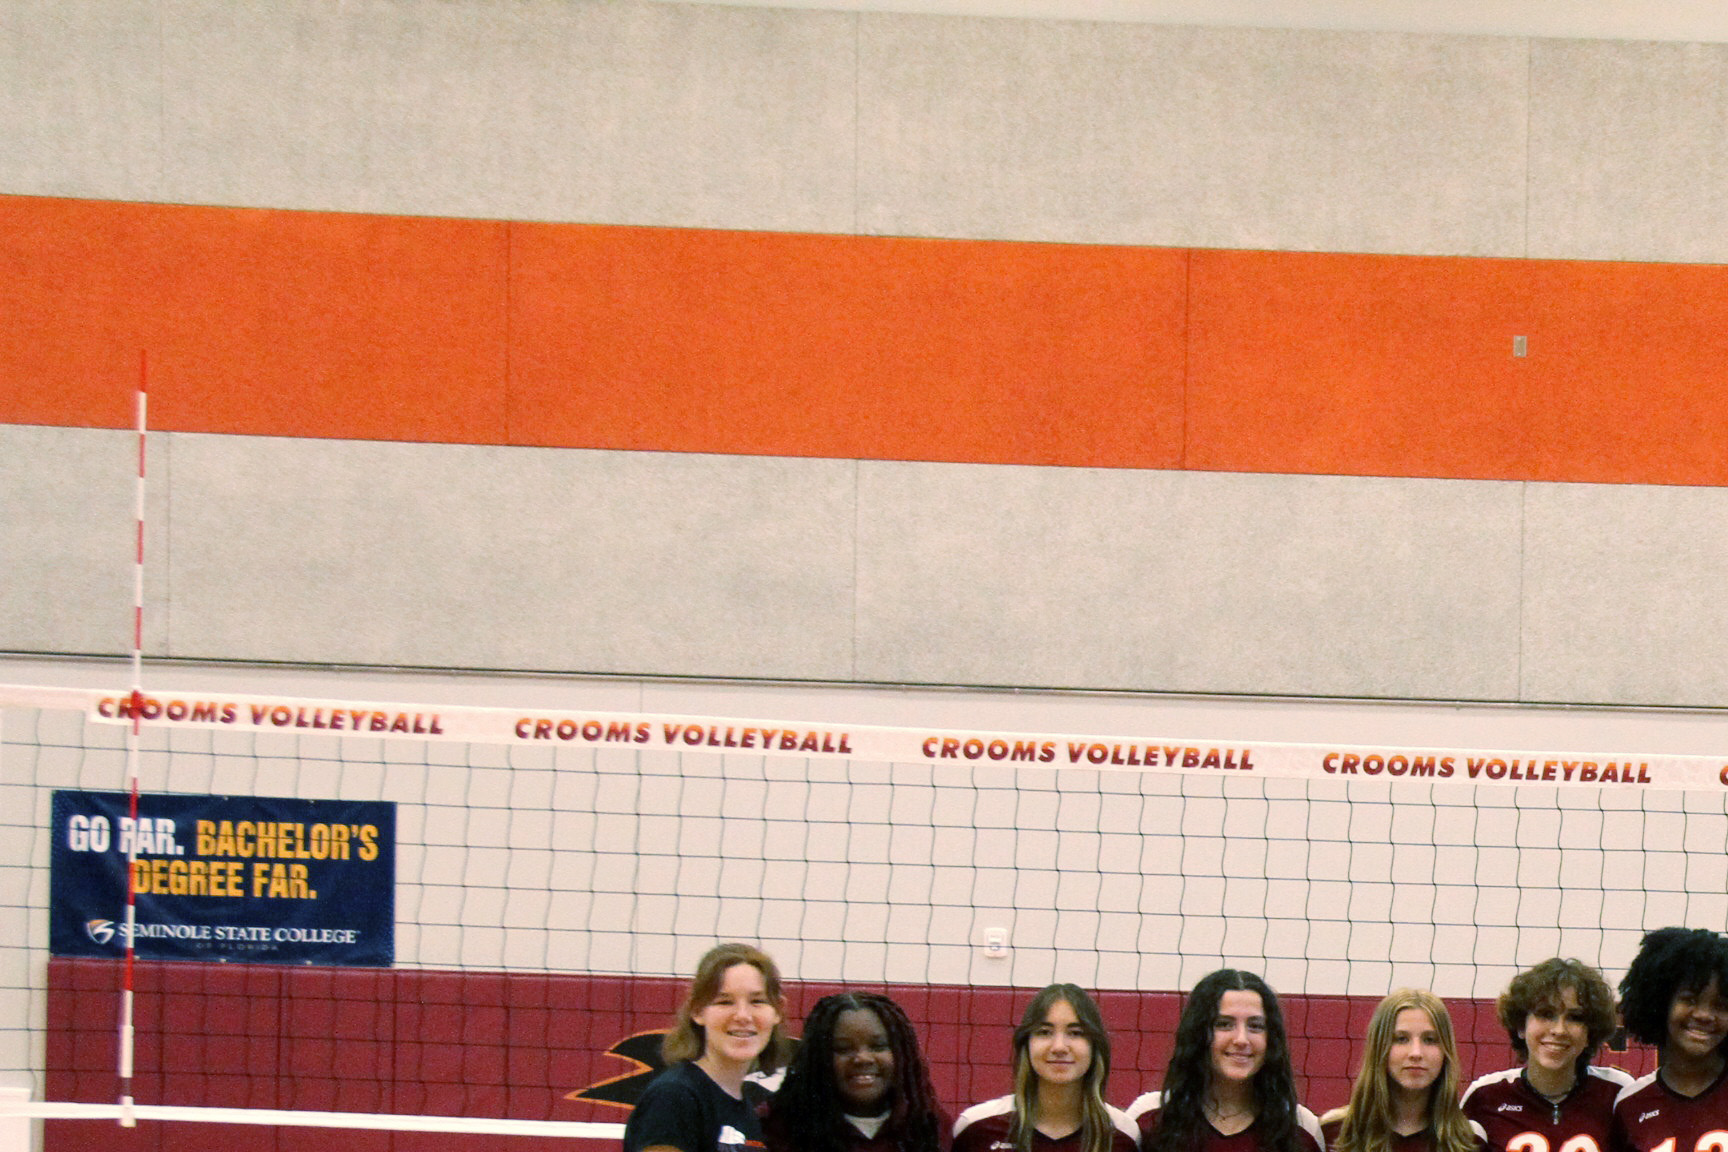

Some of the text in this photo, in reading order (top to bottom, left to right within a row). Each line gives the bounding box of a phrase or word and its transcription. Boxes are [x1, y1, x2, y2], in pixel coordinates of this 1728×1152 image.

[248, 703, 443, 734] VOLLEYBALL
[515, 717, 852, 753] CROOMS VOLLEYBALL
[922, 736, 1255, 769] CROOMS VOLLEYBALL
[1322, 752, 1652, 783] CROOMS VOLLEYBALL
[69, 814, 110, 852] GO
[195, 819, 378, 861] BACHELOR'S
[132, 858, 318, 899] DEGREE FAR.
[118, 923, 356, 944] SEMINOLE STATE COLLEGE
